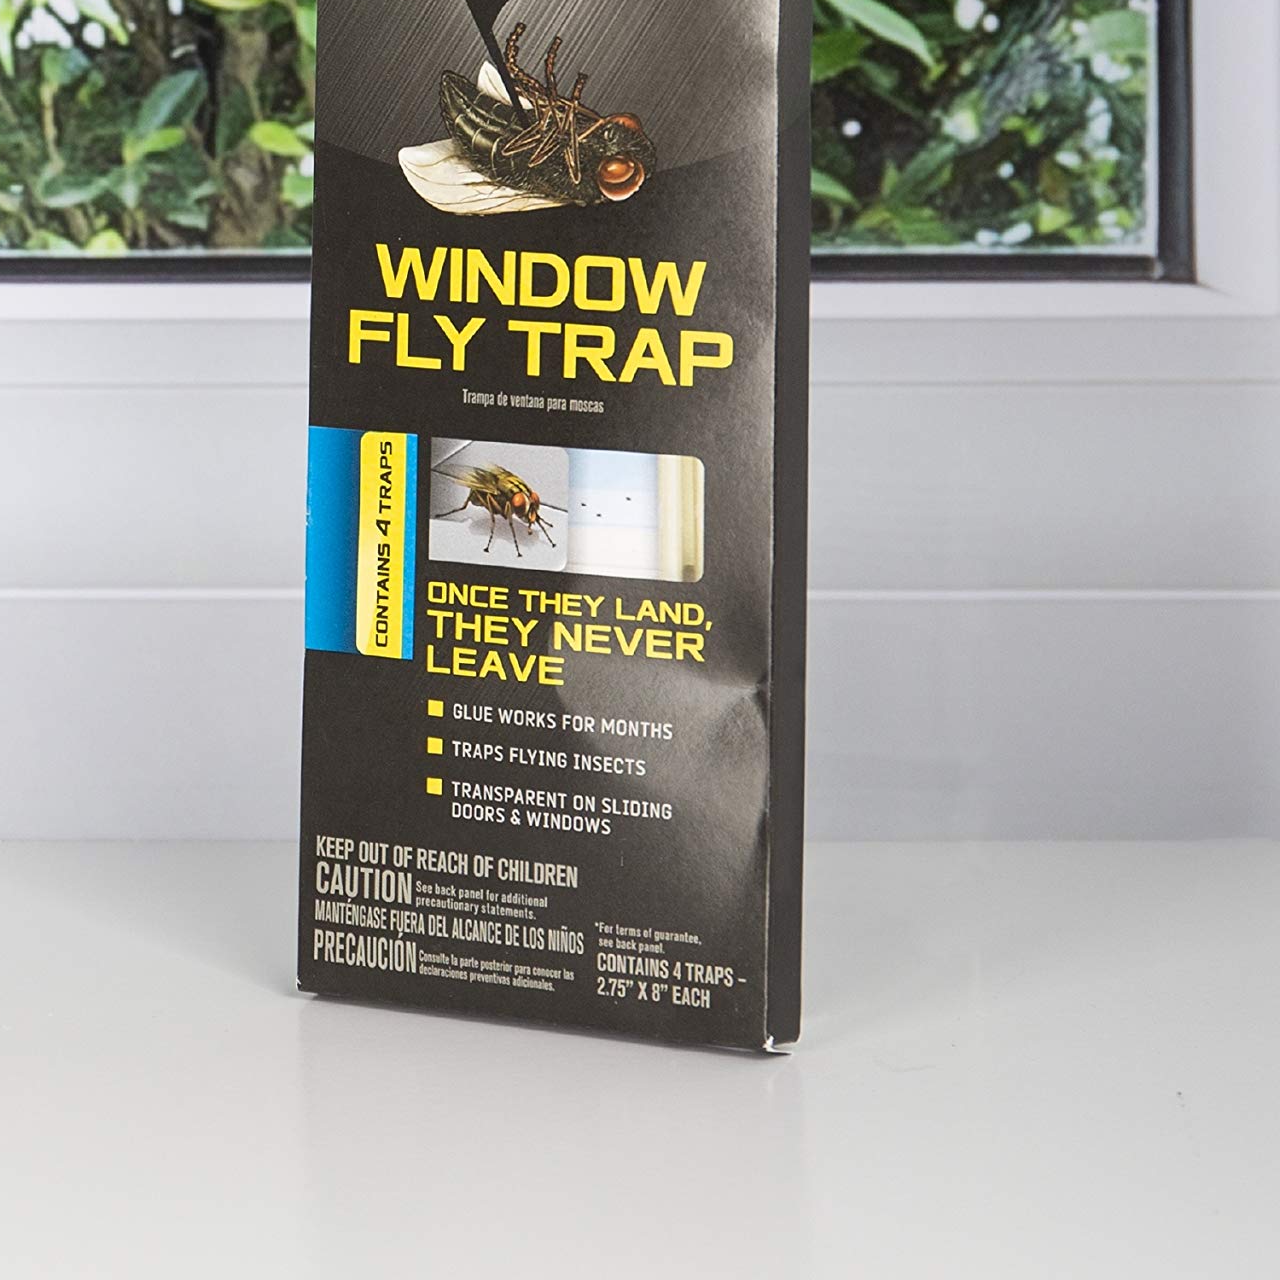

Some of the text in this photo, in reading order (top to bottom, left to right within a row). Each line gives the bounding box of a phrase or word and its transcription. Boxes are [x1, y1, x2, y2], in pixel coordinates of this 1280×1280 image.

[375, 243, 708, 317] WINDOW
[348, 309, 734, 387] FLY TRAP
[462, 388, 604, 413] Trampa de ventana para moscas
[376, 441, 393, 648] CONTAINS 4 TRAPS
[427, 581, 713, 631] ONCE THEY LAND,
[426, 609, 705, 662] THEY NEVER
[427, 644, 564, 686] LEAVE
[453, 703, 673, 740] GLUE WORKS FOR MONTHS
[452, 740, 646, 776] TRAPS FLYING INSECTS
[451, 802, 612, 835] DOORS & WINDOWS
[452, 781, 673, 820] TRANSPARENT ON SLIDING
[316, 835, 579, 888] KEEP OUT OF REACH OF CHILDREN
[316, 861, 412, 905] CAUTION
[416, 880, 548, 908] See back panel for additional
[315, 898, 584, 954] MANTÉNGASE FUERA DEL ALCANCE DE LOS NIÑOS
[416, 895, 537, 920] precautionary statements.
[598, 937, 665, 954] see back panel.
[615, 924, 641, 937] terms
[643, 927, 652, 939] of
[313, 928, 417, 973] PRECAUCIÓN
[418, 949, 574, 981] Consulte la parte posterior para conocer las
[419, 963, 468, 980] declaraciones
[470, 971, 511, 986] preventivas
[596, 952, 670, 980] CONTAINS
[673, 961, 682, 980] 4
[685, 962, 734, 988] TRAPS
[638, 981, 648, 1001] X
[672, 985, 711, 1009] EACH
